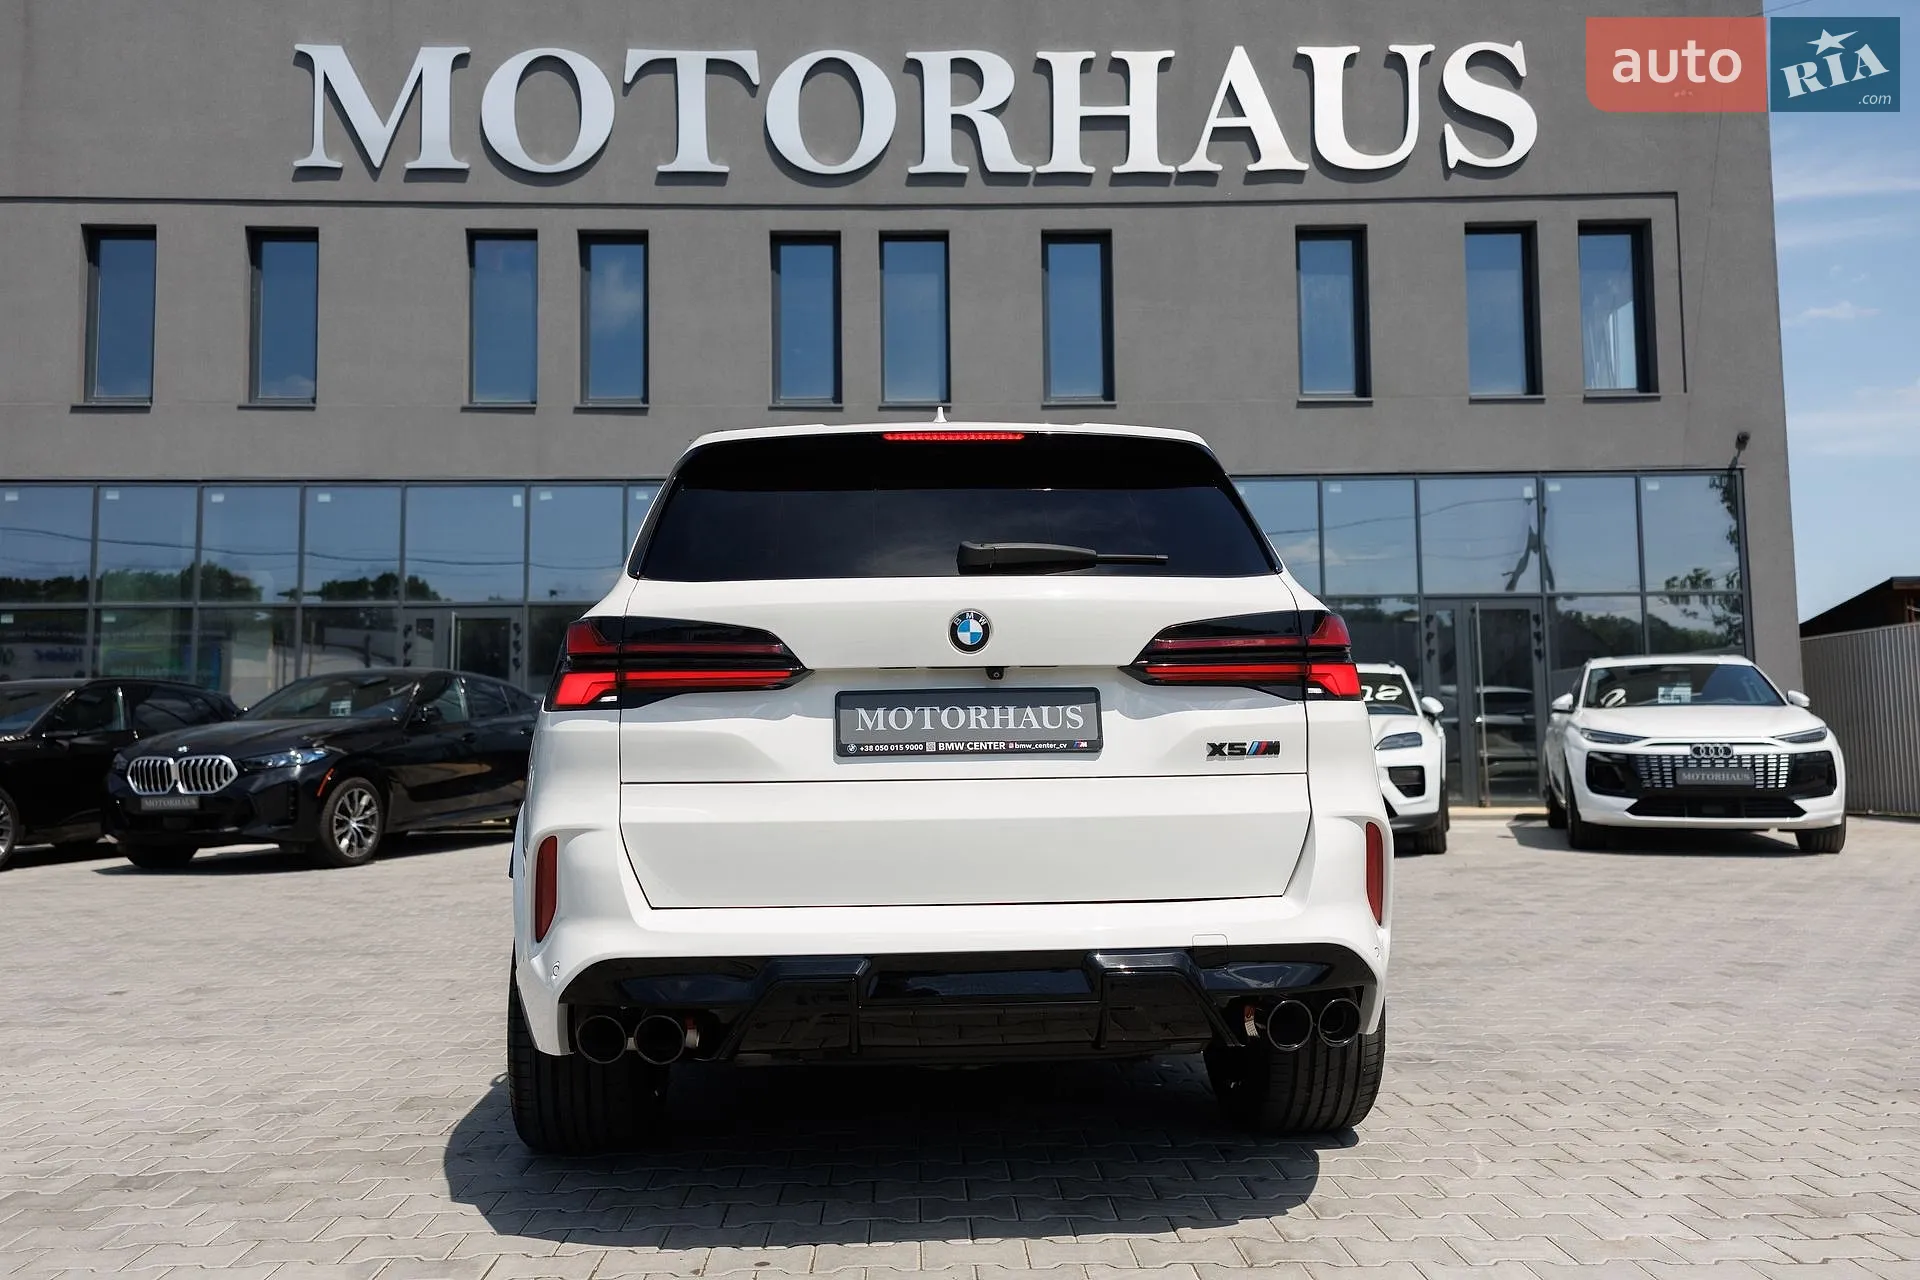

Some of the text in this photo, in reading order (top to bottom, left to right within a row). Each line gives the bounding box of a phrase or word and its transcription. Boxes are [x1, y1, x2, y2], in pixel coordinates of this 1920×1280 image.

[292, 40, 1538, 175] MOTORHAUS
[855, 705, 1084, 731] MOTORHAUS
[860, 744, 873, 752] +38
[875, 744, 889, 752] 050
[905, 743, 923, 751] 9000
[938, 741, 1006, 751] BMW CENTER
[1682, 772, 1750, 781] MOTORHAUS
